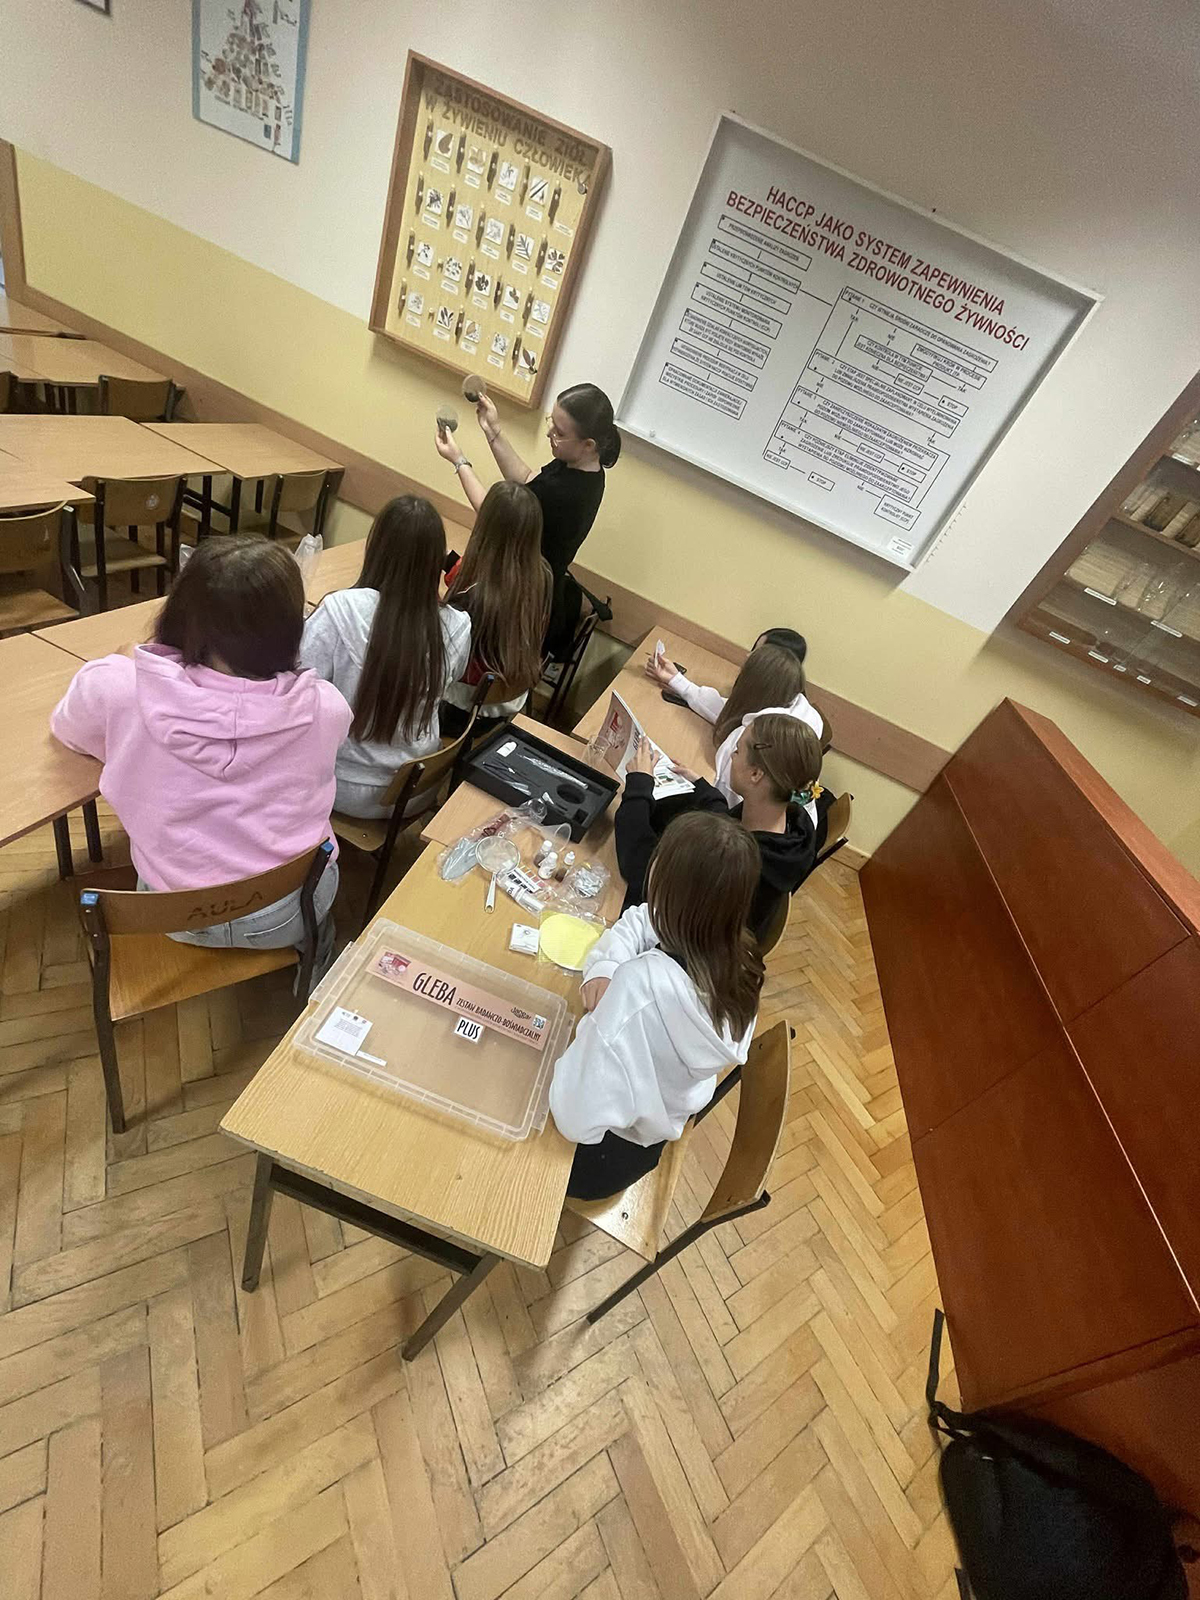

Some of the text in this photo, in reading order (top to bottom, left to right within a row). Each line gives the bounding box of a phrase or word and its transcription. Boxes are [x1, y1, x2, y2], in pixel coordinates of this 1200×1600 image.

[423, 93, 437, 113] W
[441, 97, 509, 148] ŻYWIENIU
[431, 75, 548, 146] ZASTOSOWANIE
[724, 188, 1031, 351] BEZPIECZEŃSTWA ZDROWOTNEGO ŻYWNOŚCI
[764, 185, 1008, 316] HACCP JAKO SYSTEM ZAPEWNIENIA
[412, 972, 457, 1006] GLEBA
[456, 998, 477, 1012] ZESTAW
[456, 1019, 481, 1040] PLUS
